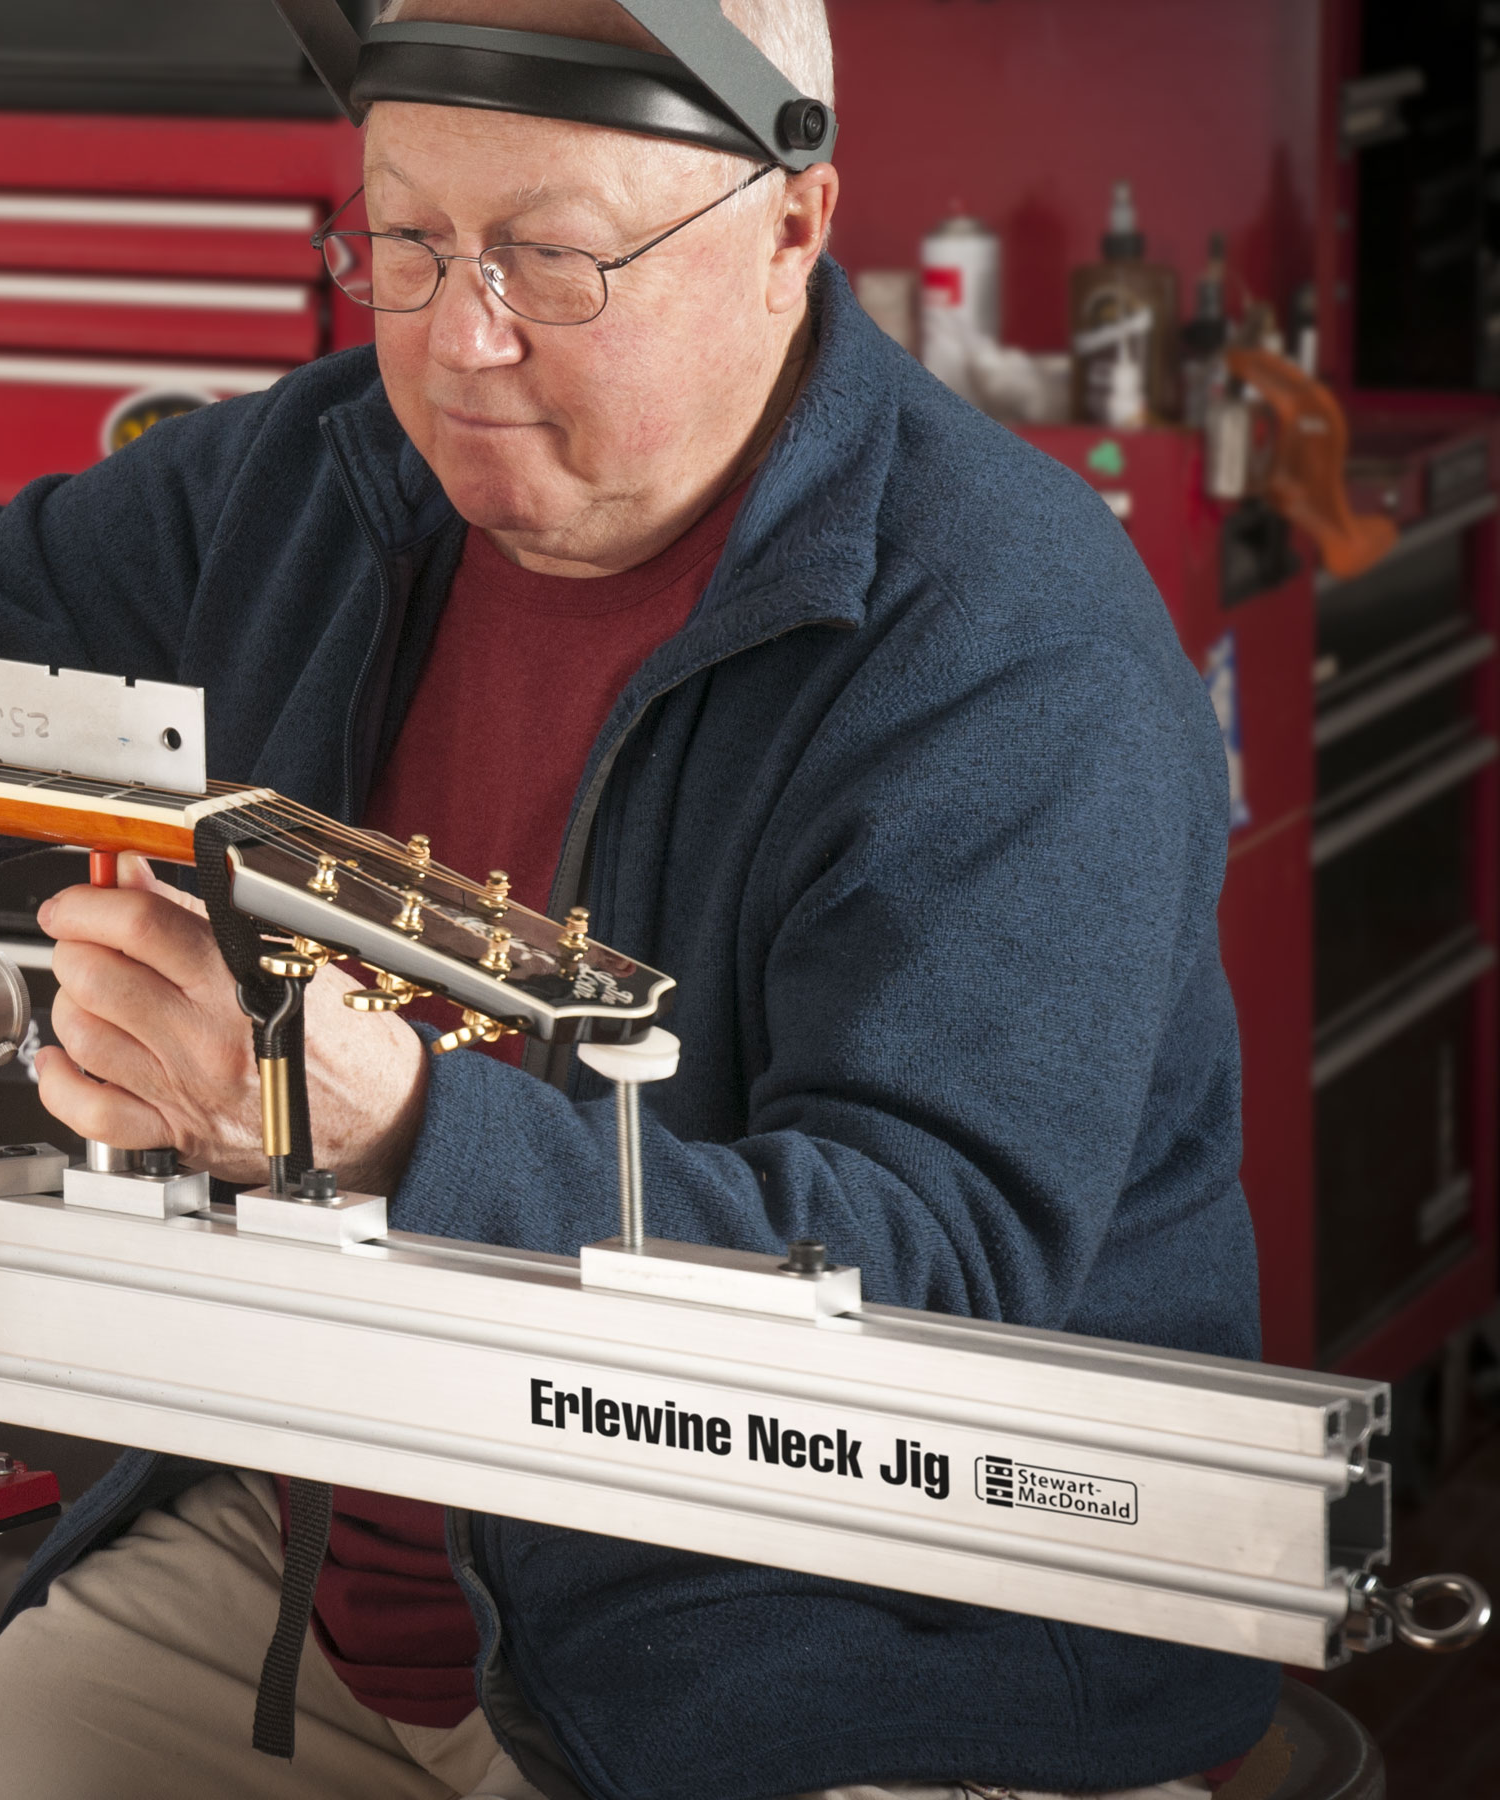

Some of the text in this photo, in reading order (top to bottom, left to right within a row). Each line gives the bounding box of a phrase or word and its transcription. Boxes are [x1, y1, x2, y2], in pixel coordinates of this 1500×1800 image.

[530, 1377, 950, 1500] Erlewine Neck Jig
[1017, 1468, 1102, 1497] Stewart-
[1018, 1485, 1131, 1519] MacDonald
